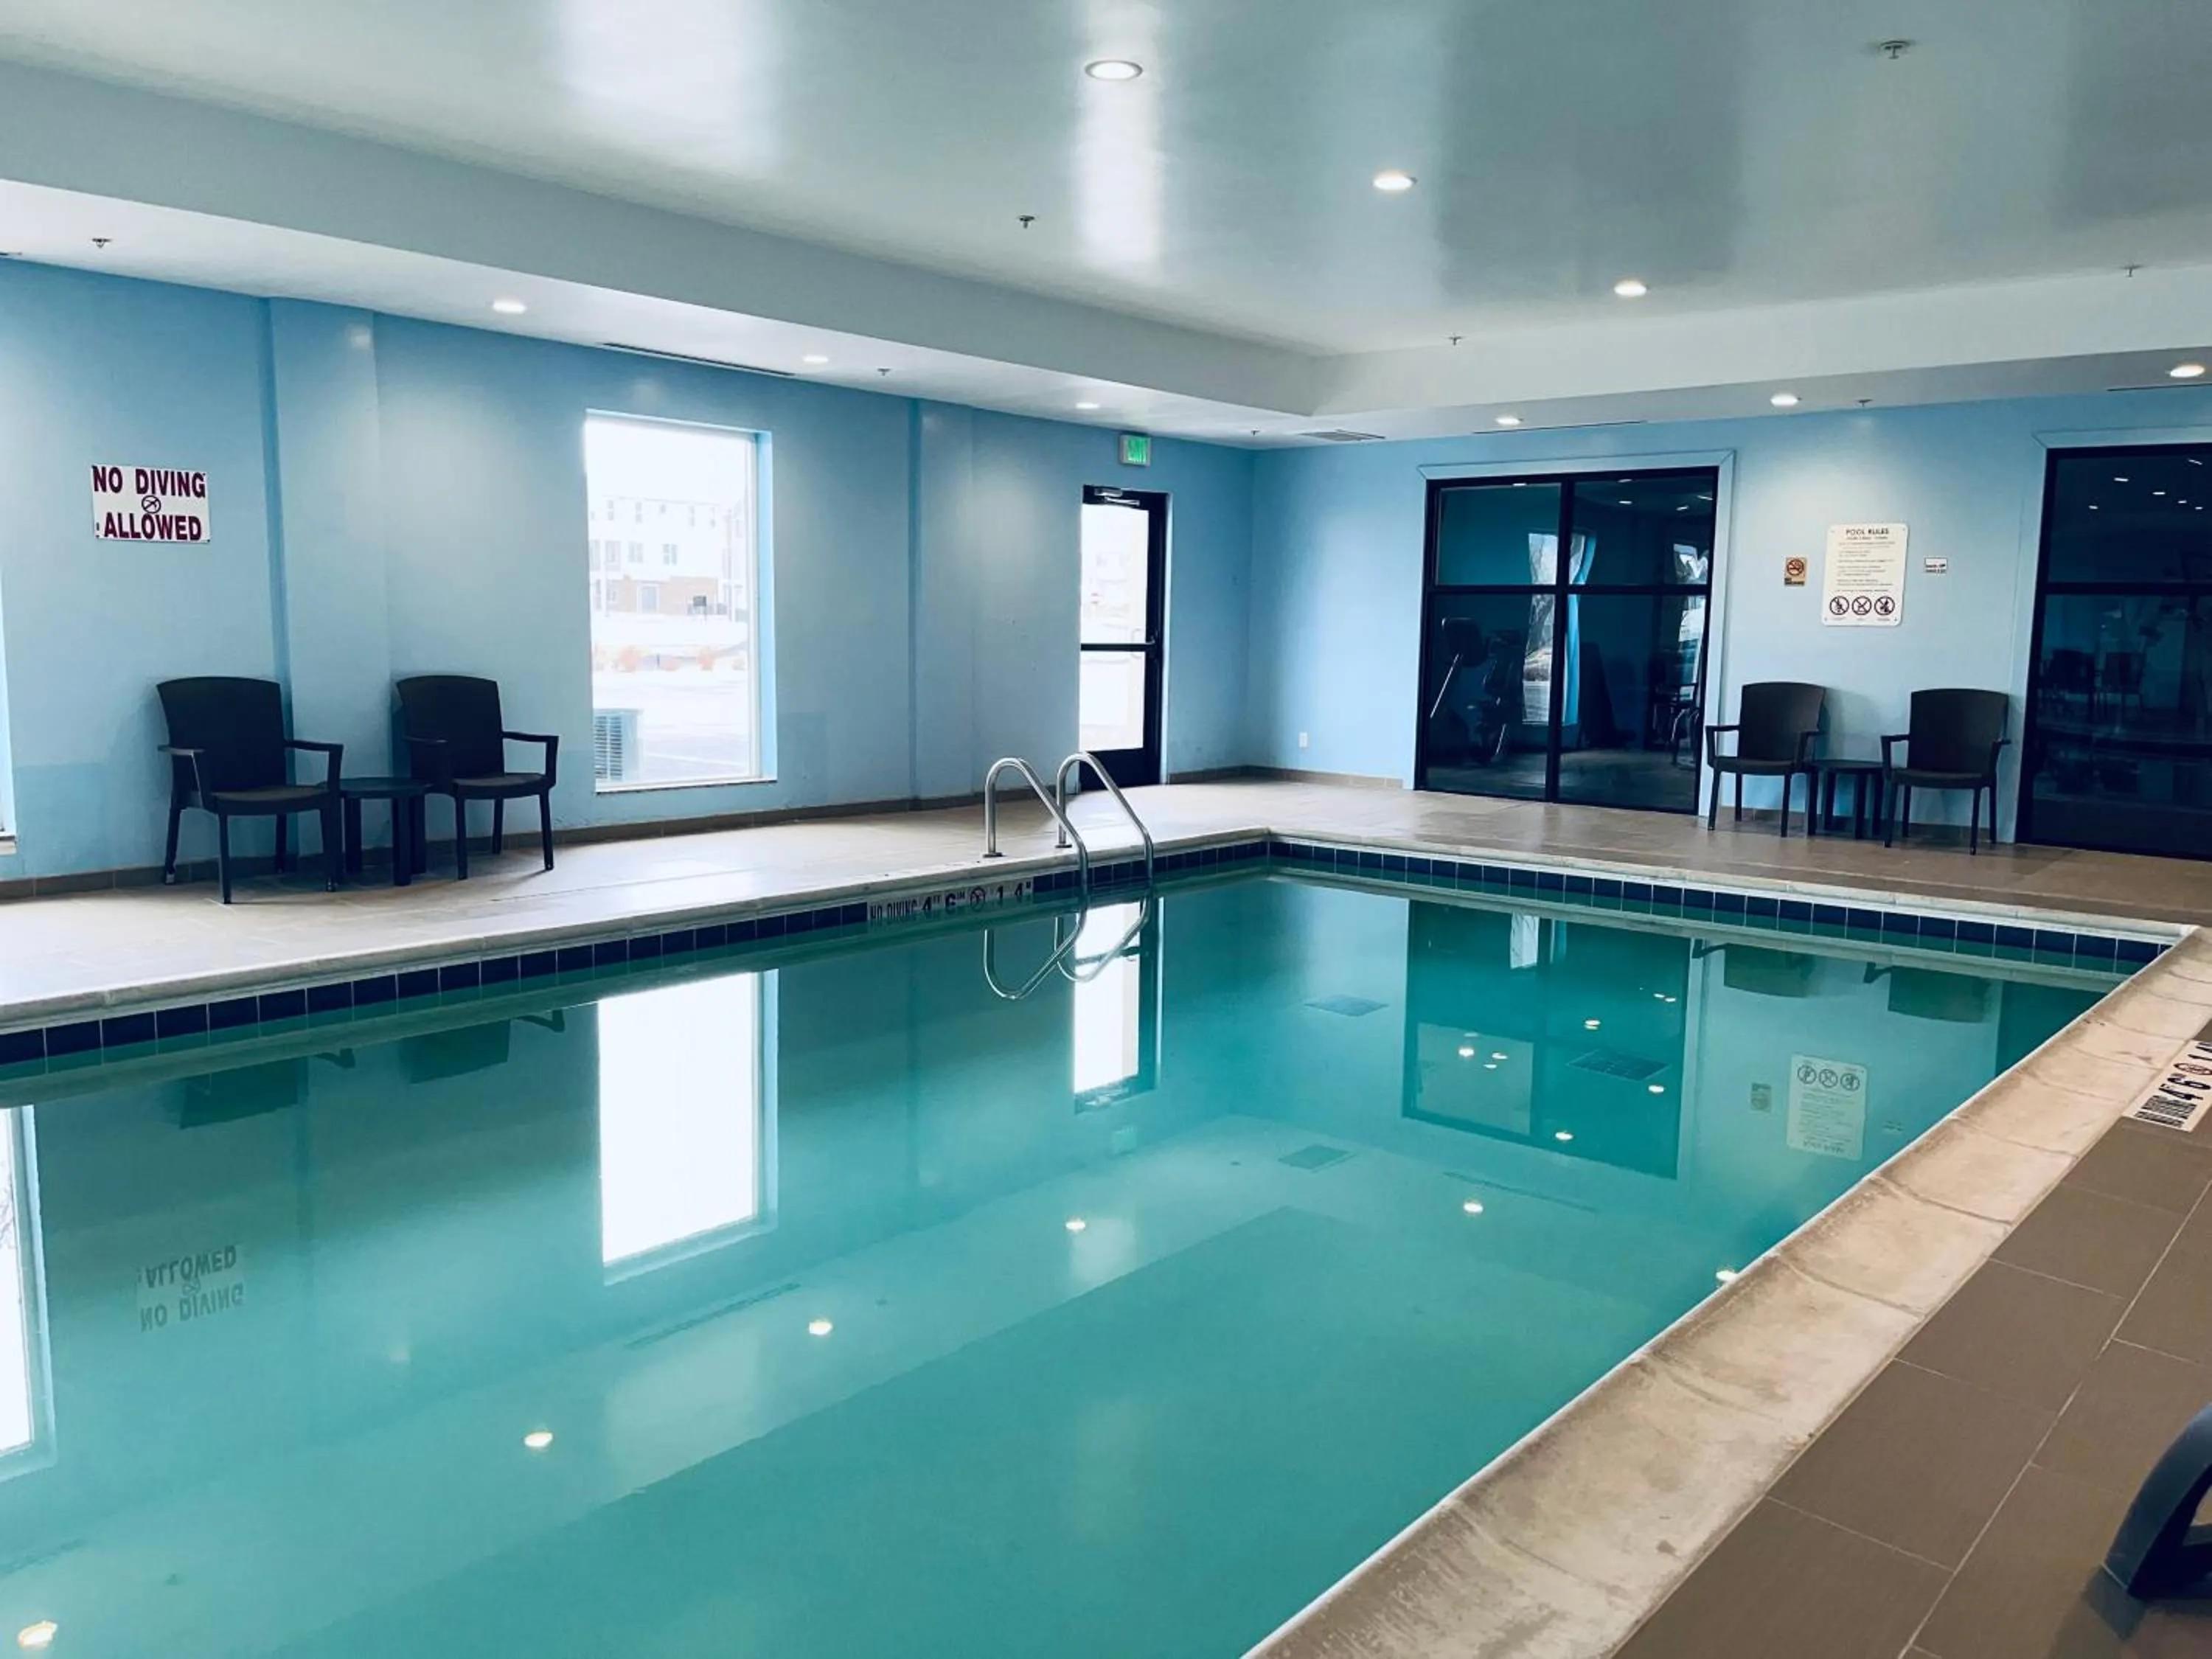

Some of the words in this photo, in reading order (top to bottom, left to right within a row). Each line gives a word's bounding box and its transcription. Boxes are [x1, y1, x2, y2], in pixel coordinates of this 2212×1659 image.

[92, 466, 123, 493] NO
[135, 468, 206, 498] DIVING
[105, 512, 201, 540] ALLOWED
